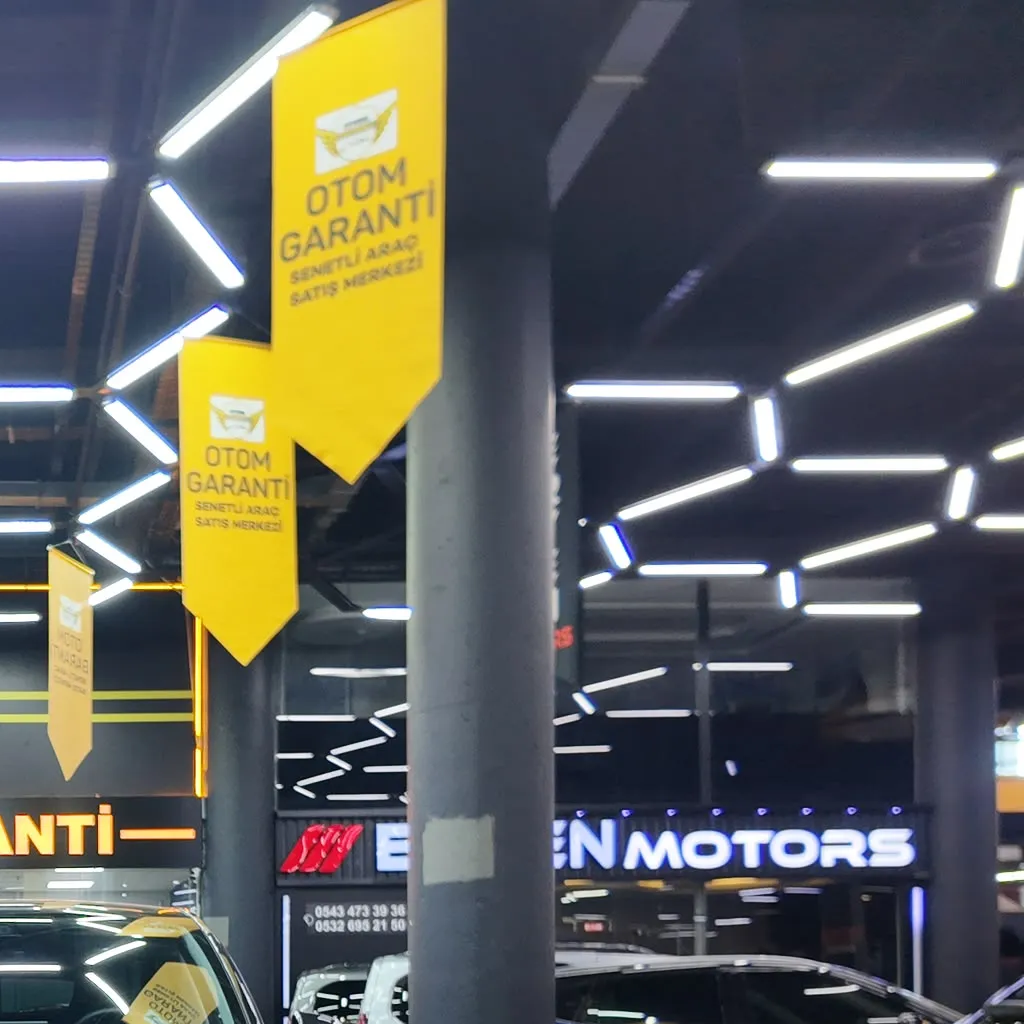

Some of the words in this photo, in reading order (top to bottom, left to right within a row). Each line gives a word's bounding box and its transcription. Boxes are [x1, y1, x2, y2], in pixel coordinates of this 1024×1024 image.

[306, 157, 407, 217] OTOM
[279, 179, 437, 264] GARANTİ
[289, 246, 361, 285] SENETLİ
[206, 446, 271, 472] OTOM
[187, 472, 291, 500] GARANTİ
[623, 828, 916, 870] MOTORS
